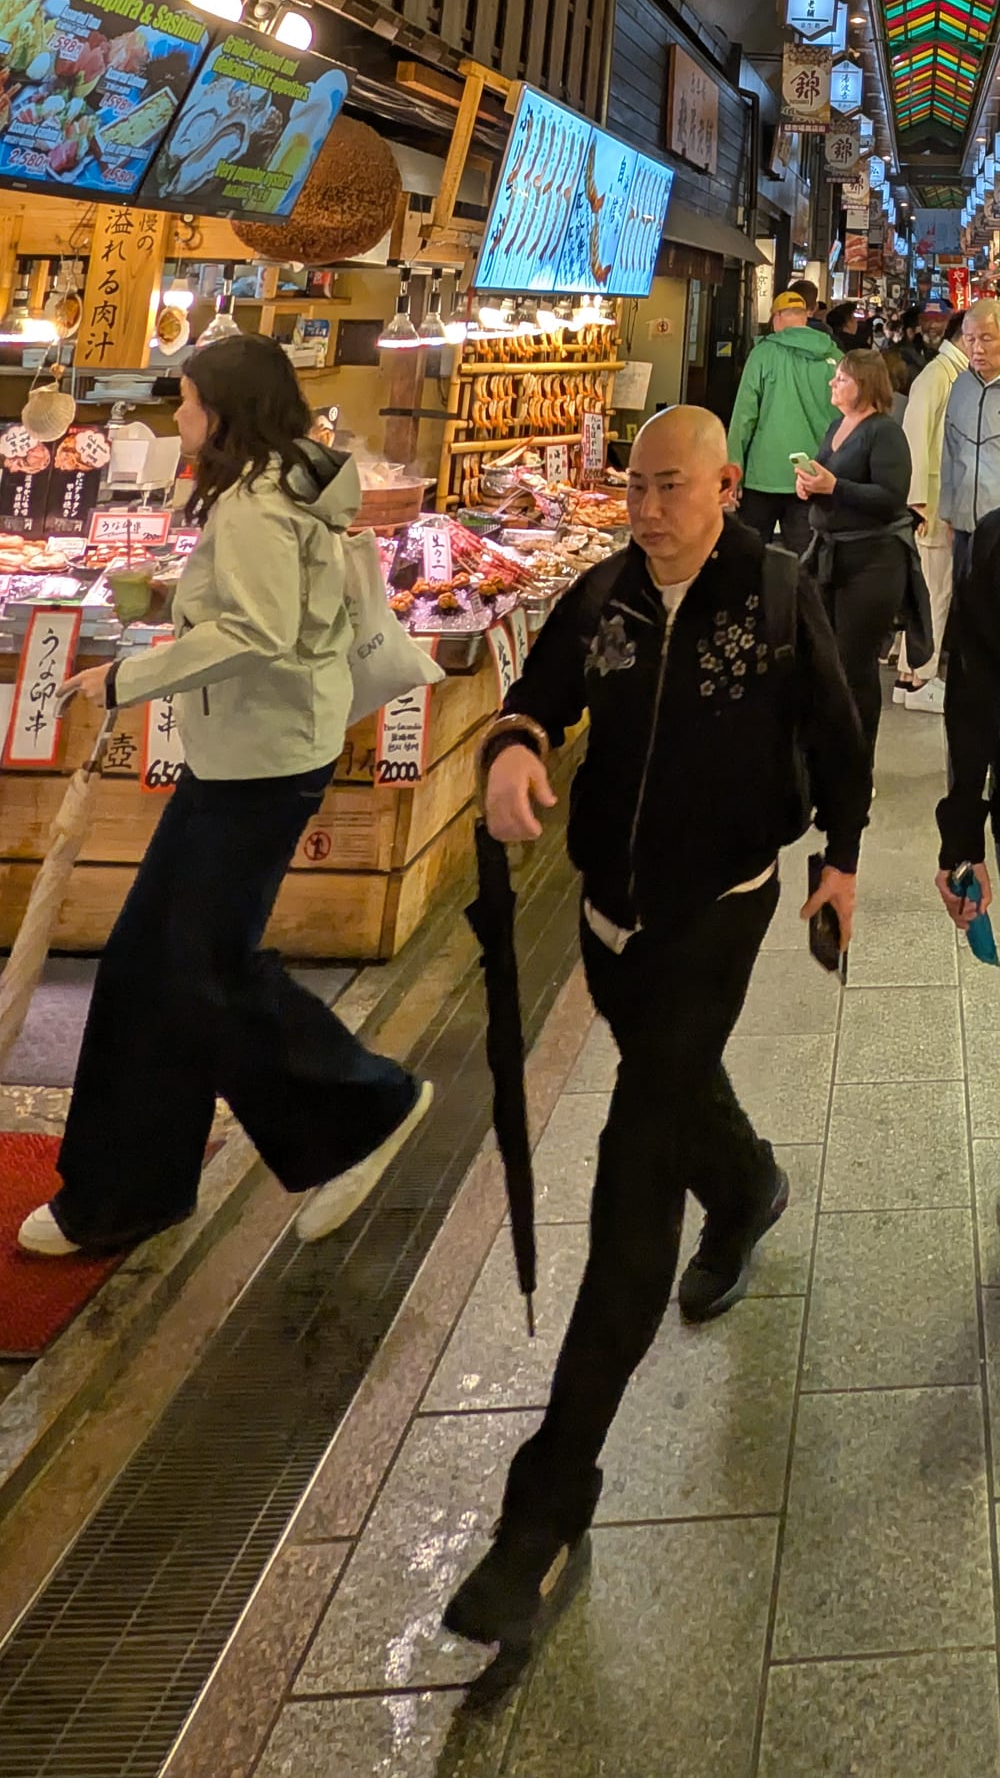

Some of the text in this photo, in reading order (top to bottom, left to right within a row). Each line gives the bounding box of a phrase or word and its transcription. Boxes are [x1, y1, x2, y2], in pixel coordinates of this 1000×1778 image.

[153, 6, 206, 44] Sashimi
[790, 69, 821, 106] 錦
[831, 137, 853, 163] 錦
[85, 207, 134, 363] 溢れる肉汁
